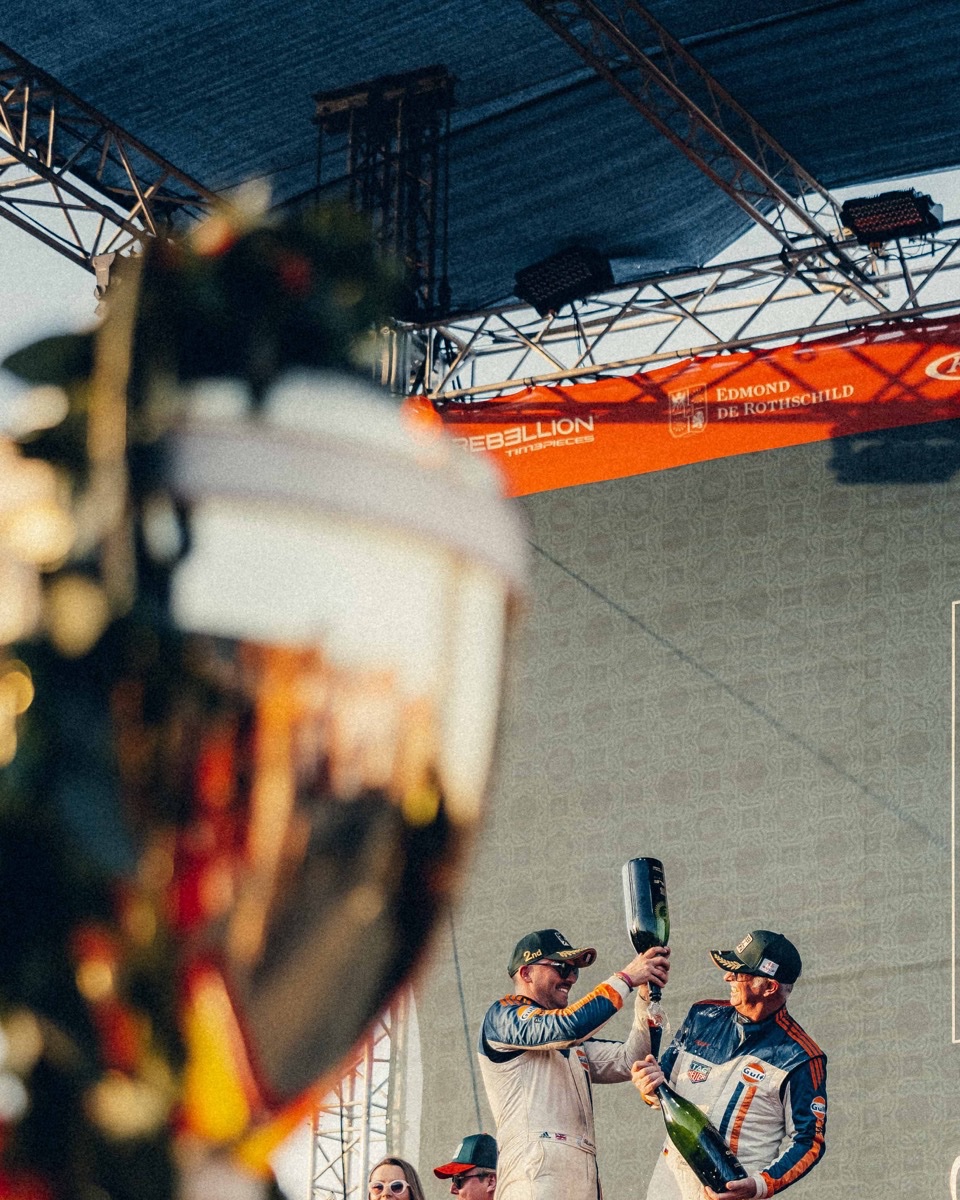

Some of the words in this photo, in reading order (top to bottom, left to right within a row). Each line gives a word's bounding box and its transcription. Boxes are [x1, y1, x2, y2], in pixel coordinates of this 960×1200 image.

[716, 380, 790, 402] EDMOND
[717, 406, 739, 420] DE
[743, 384, 855, 416] ROTHSCHILD
[523, 949, 542, 962] 2nd
[691, 1062, 708, 1074] TAG
[743, 1066, 765, 1080] Gulf
